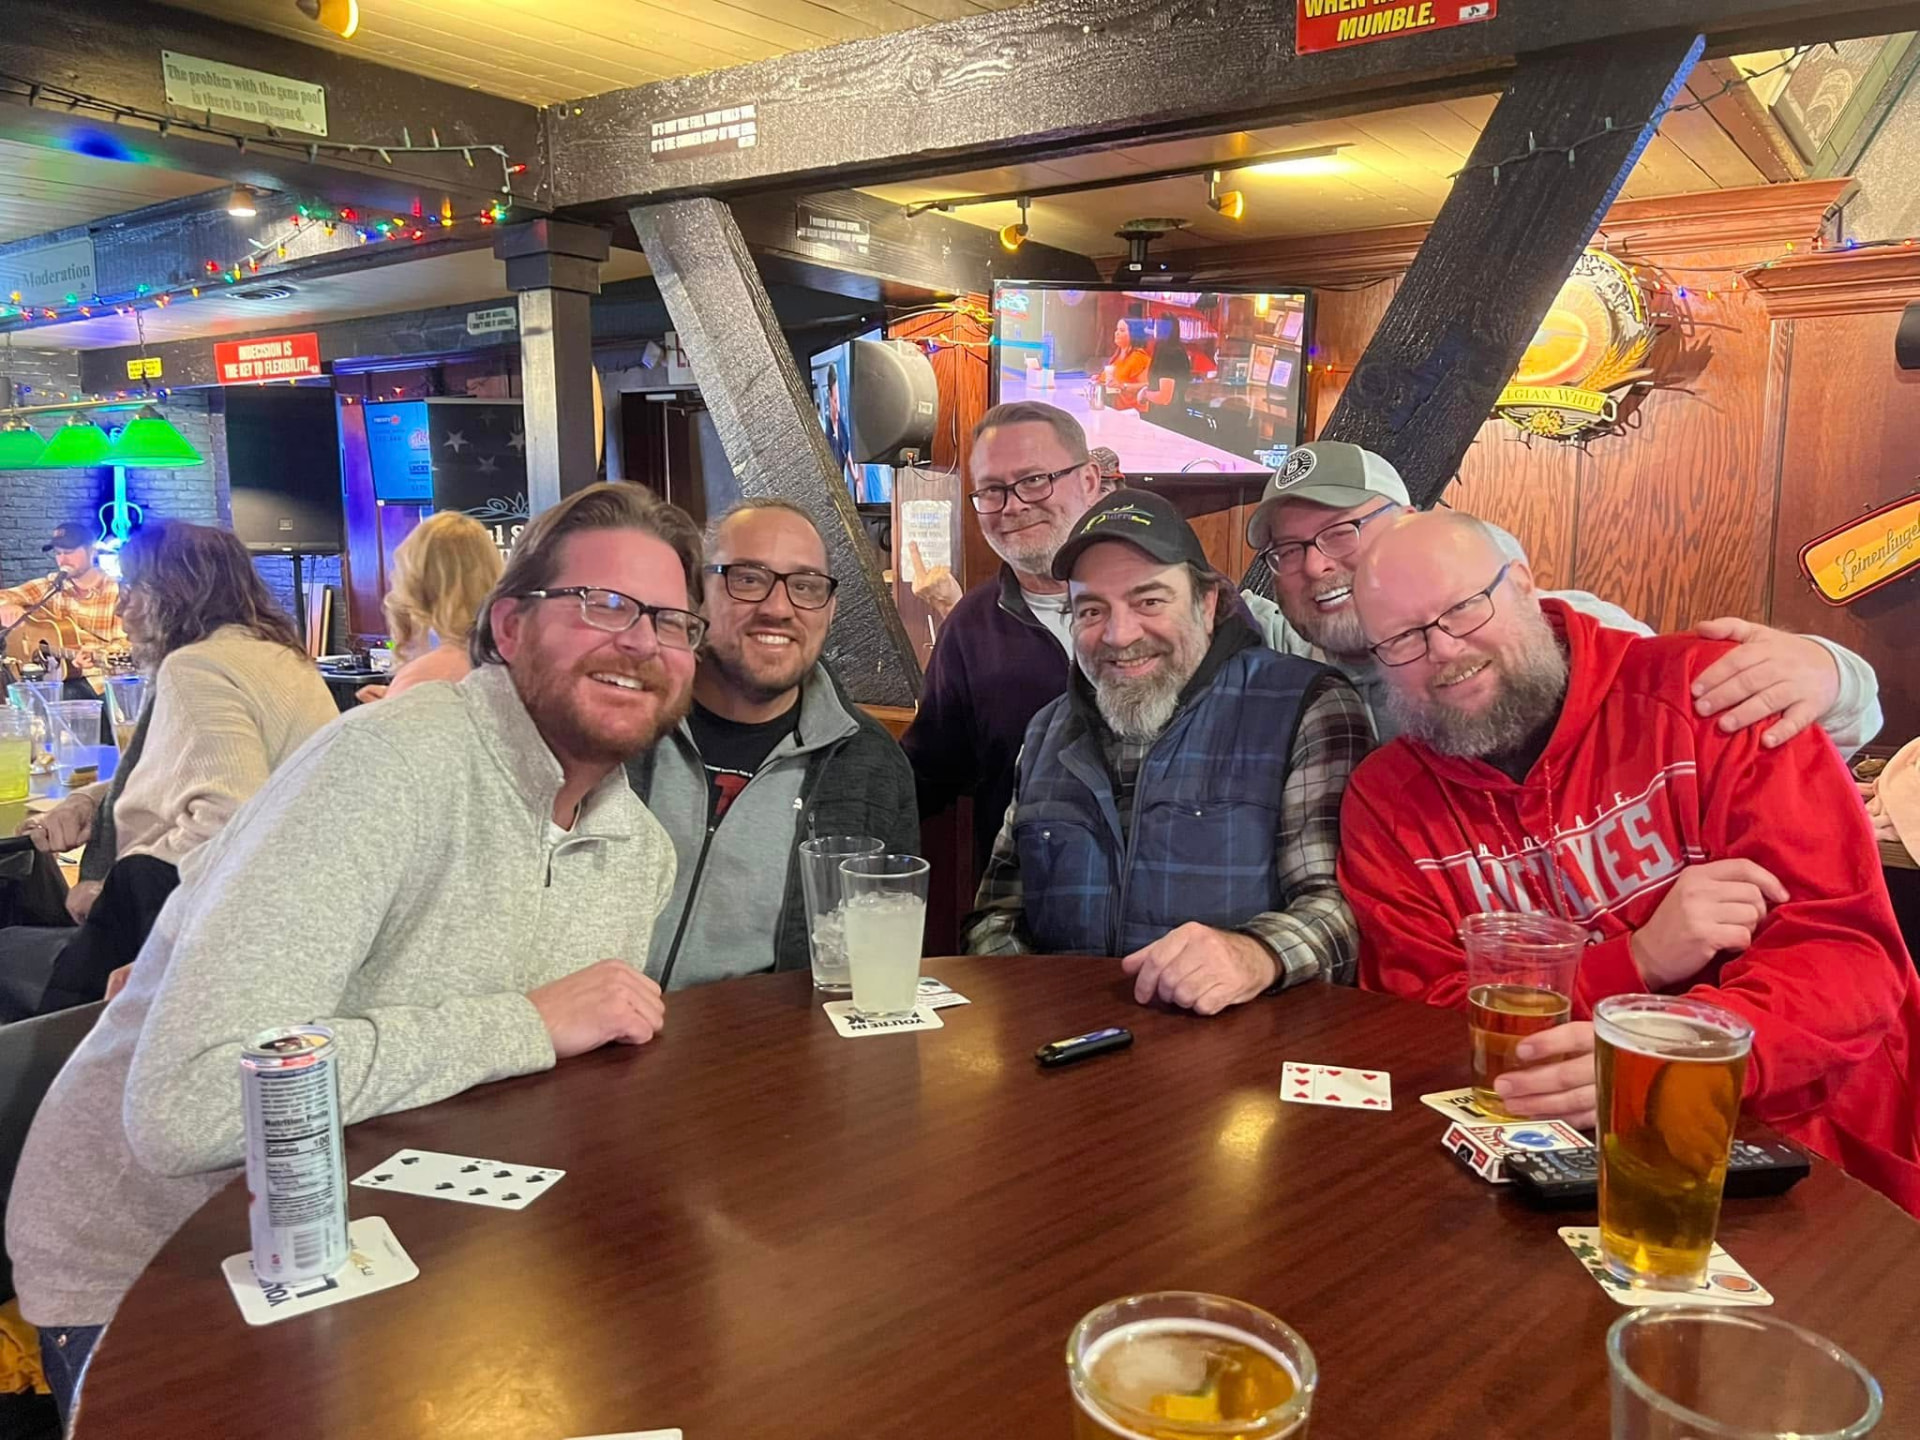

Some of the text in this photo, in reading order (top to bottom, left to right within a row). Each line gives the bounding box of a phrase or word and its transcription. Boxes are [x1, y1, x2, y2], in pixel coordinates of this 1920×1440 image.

[1337, 2, 1436, 42] MUMBLE.
[166, 64, 187, 81] The
[189, 70, 232, 89] problem
[233, 77, 258, 94] with
[259, 80, 276, 96] the
[300, 89, 322, 105] pool
[23, 263, 91, 288] Moderation
[238, 340, 292, 361] INDECISION IS
[224, 363, 239, 379] THE
[1506, 388, 1552, 401] LGIAN
[1446, 1095, 1476, 1106] YOU
[265, 1117, 304, 1127] Nutrition
[313, 1134, 330, 1147] 100
[258, 1278, 292, 1307] YOU
